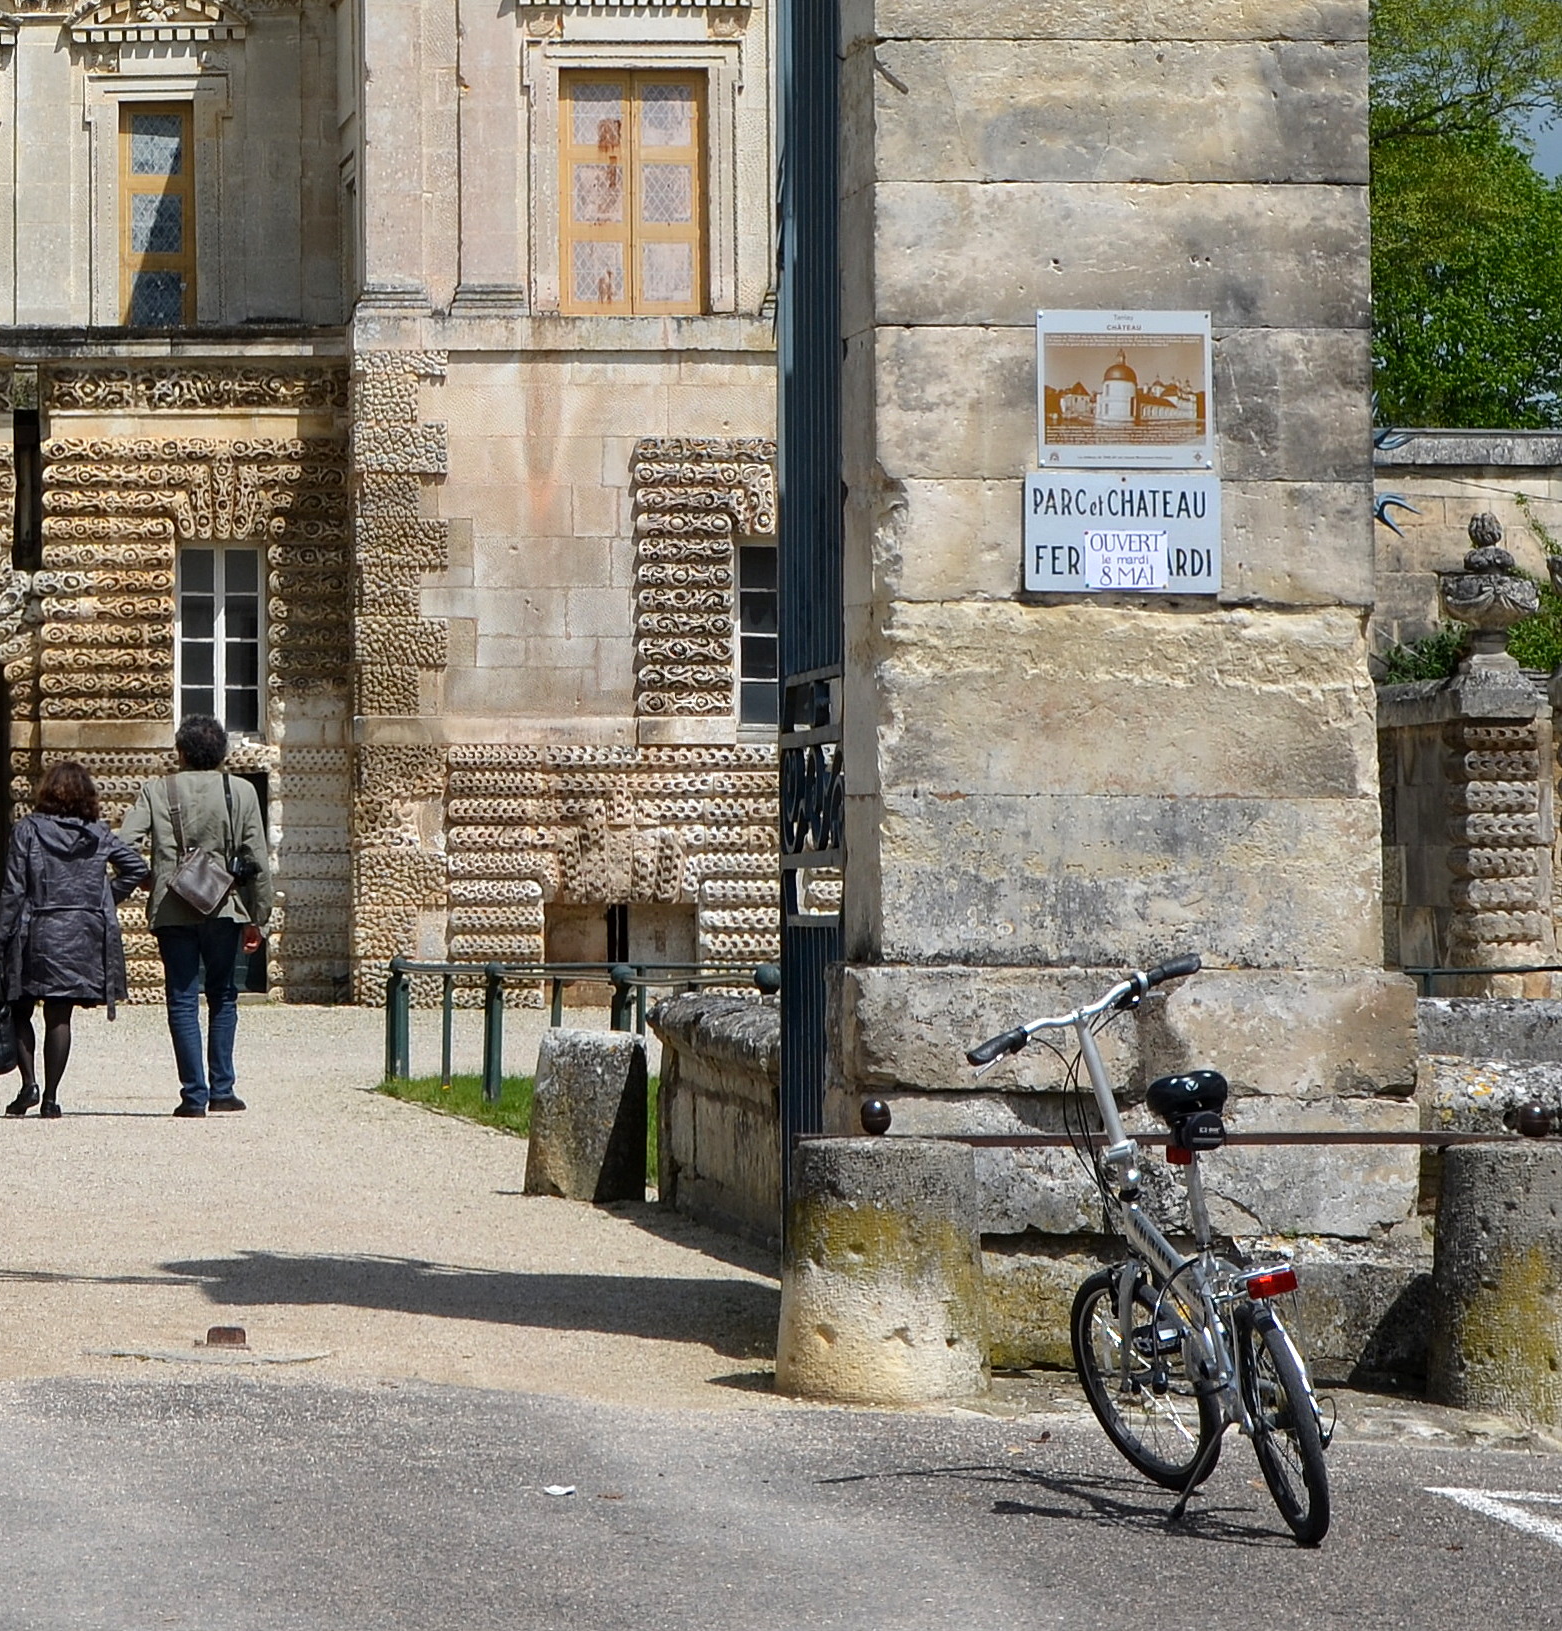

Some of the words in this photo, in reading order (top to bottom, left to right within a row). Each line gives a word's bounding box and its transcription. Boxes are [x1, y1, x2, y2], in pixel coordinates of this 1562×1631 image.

[1032, 488, 1086, 515] PARC
[1090, 495, 1104, 517] et
[1107, 489, 1206, 518] CHATEAU
[1090, 533, 1165, 552] OUVERT
[1035, 545, 1086, 575] FER
[1101, 554, 1111, 565] le
[1117, 555, 1149, 565] mardi
[1099, 566, 1113, 586] 8
[1118, 565, 1155, 586] MAI
